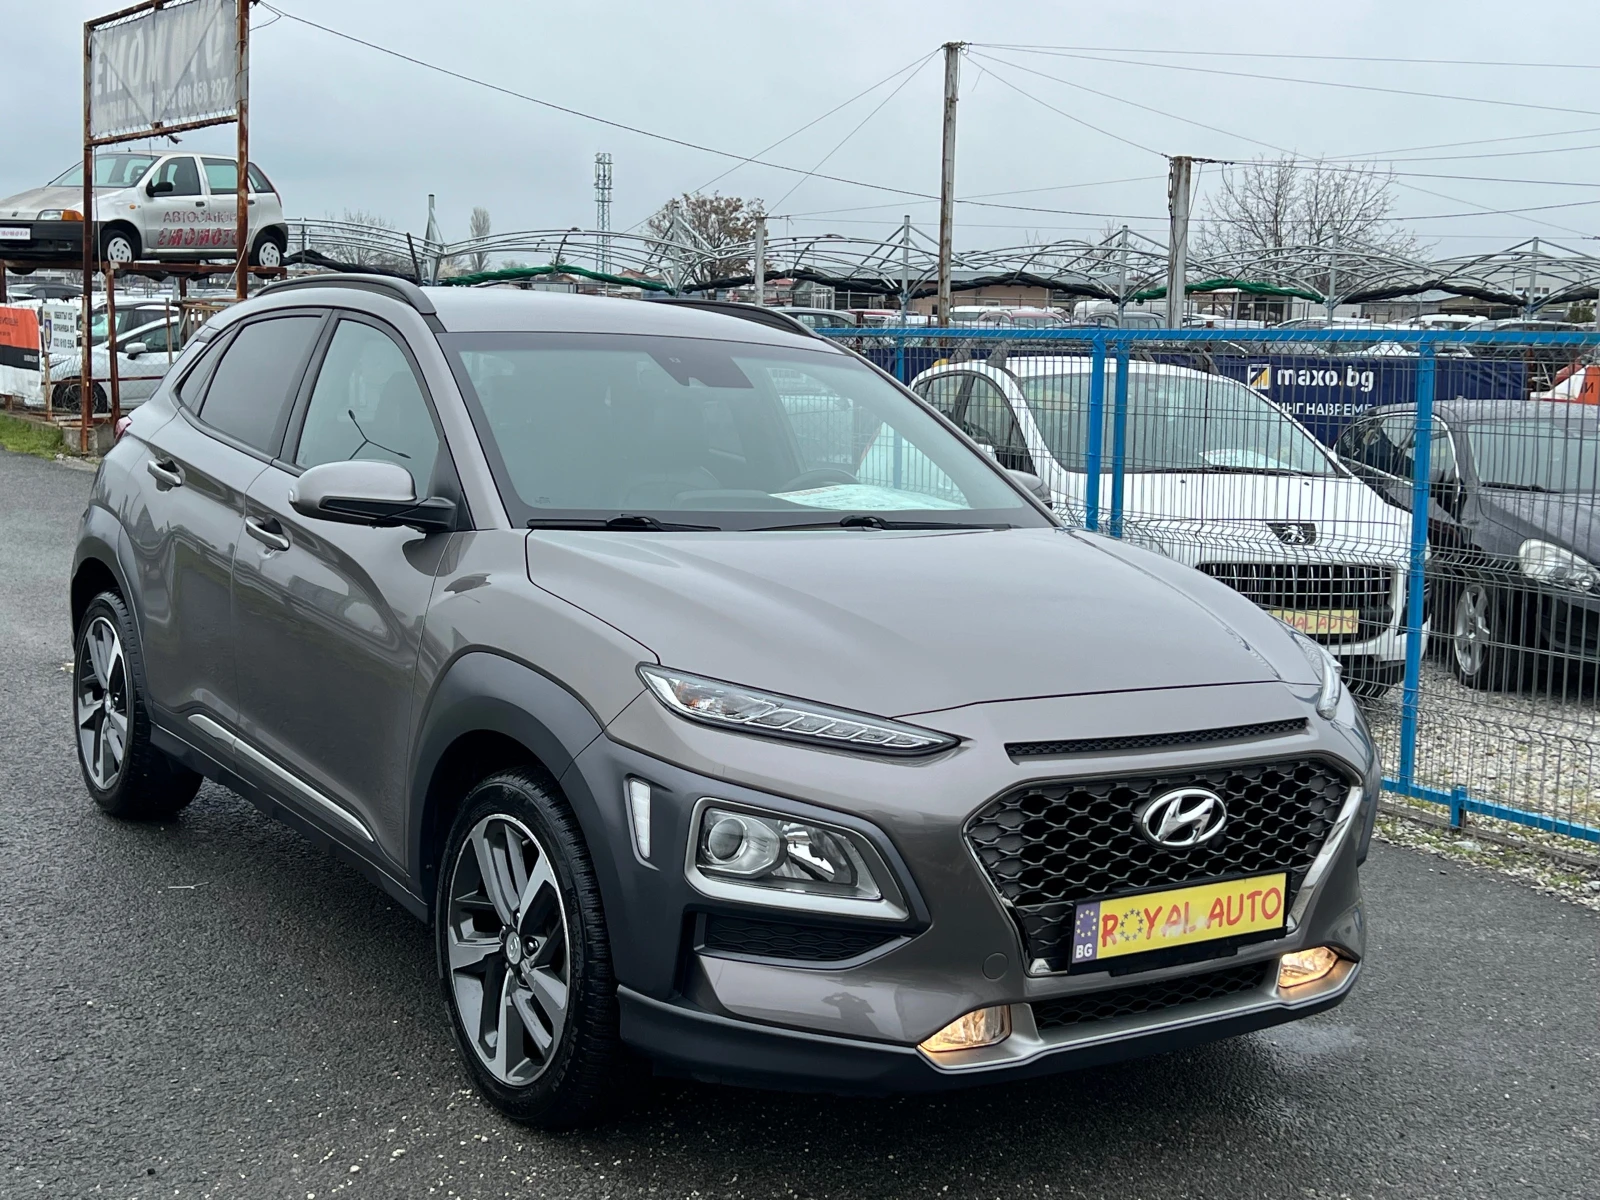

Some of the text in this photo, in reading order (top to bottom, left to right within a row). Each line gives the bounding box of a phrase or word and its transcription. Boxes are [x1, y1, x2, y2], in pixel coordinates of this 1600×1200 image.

[1277, 365, 1374, 393] maxo.bg
[1278, 402, 1304, 415] ИНГ
[1285, 615, 1313, 630] YAL
[1206, 887, 1282, 930] AUTO
[1075, 942, 1093, 959] BG
